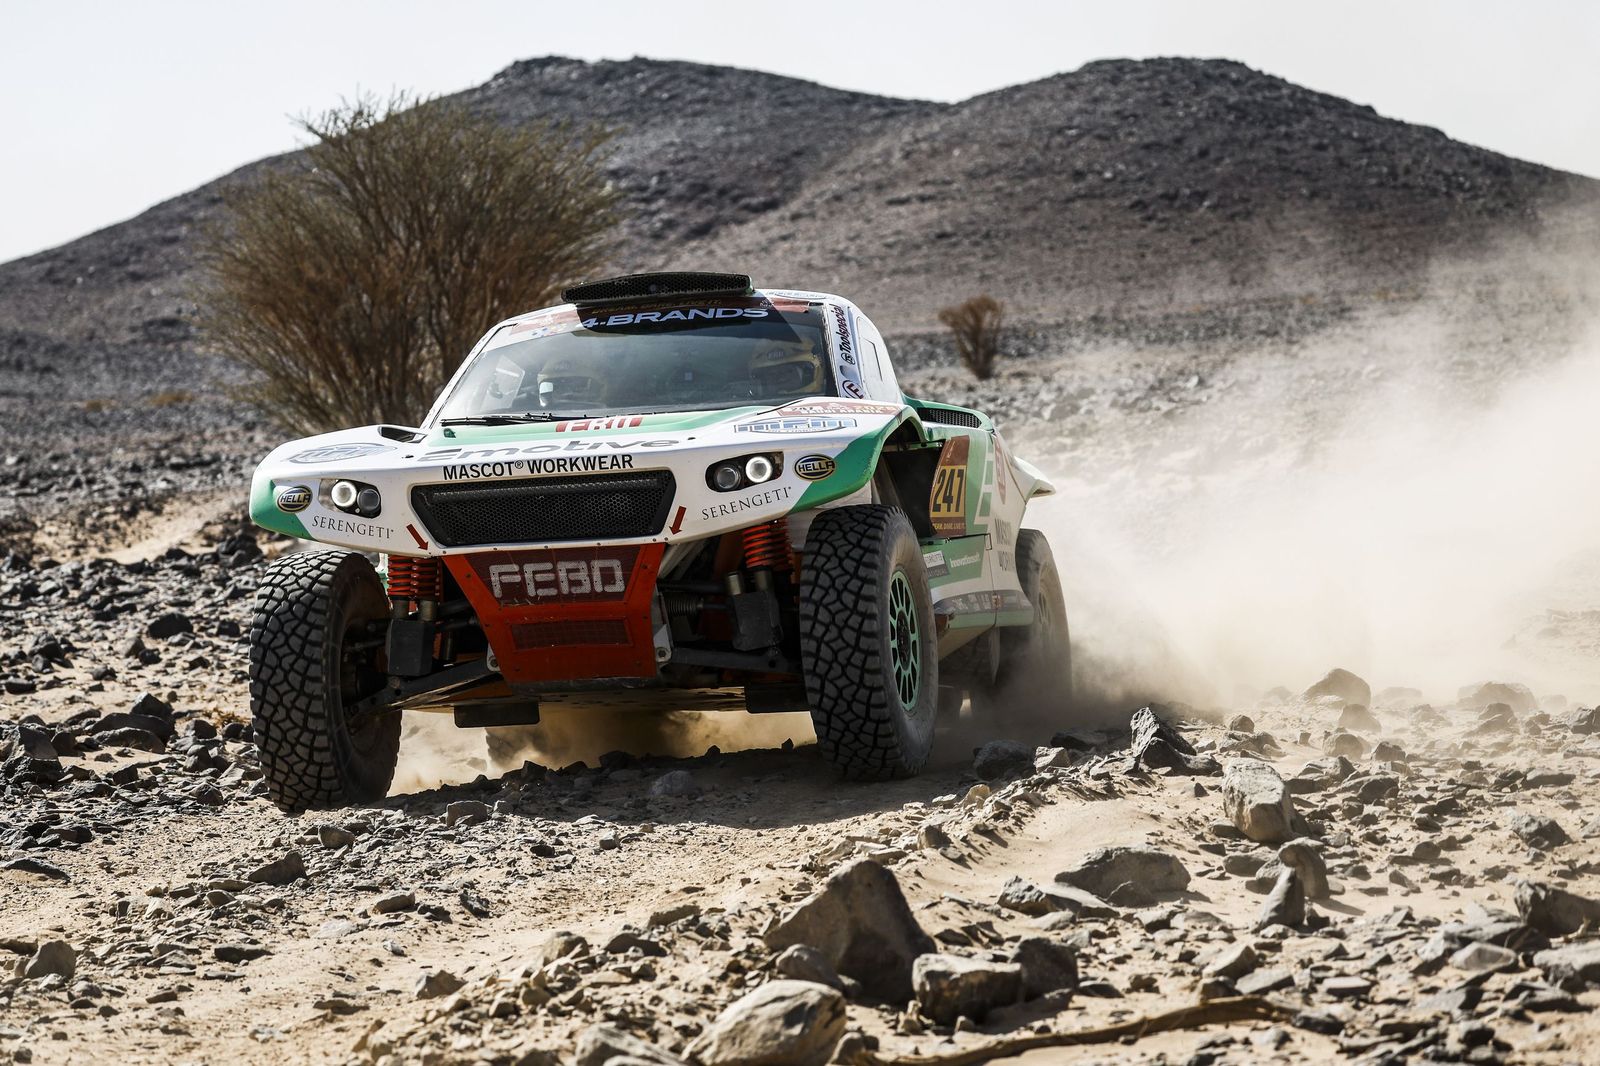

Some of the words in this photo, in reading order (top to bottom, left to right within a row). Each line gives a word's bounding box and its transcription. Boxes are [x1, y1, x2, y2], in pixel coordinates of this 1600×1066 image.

[418, 440, 679, 462] Emotive
[529, 454, 634, 474] WORKWEAR
[798, 460, 835, 473] HELLA
[278, 493, 311, 505] HELLA
[932, 469, 964, 512] 247
[488, 559, 626, 599] FEBO
